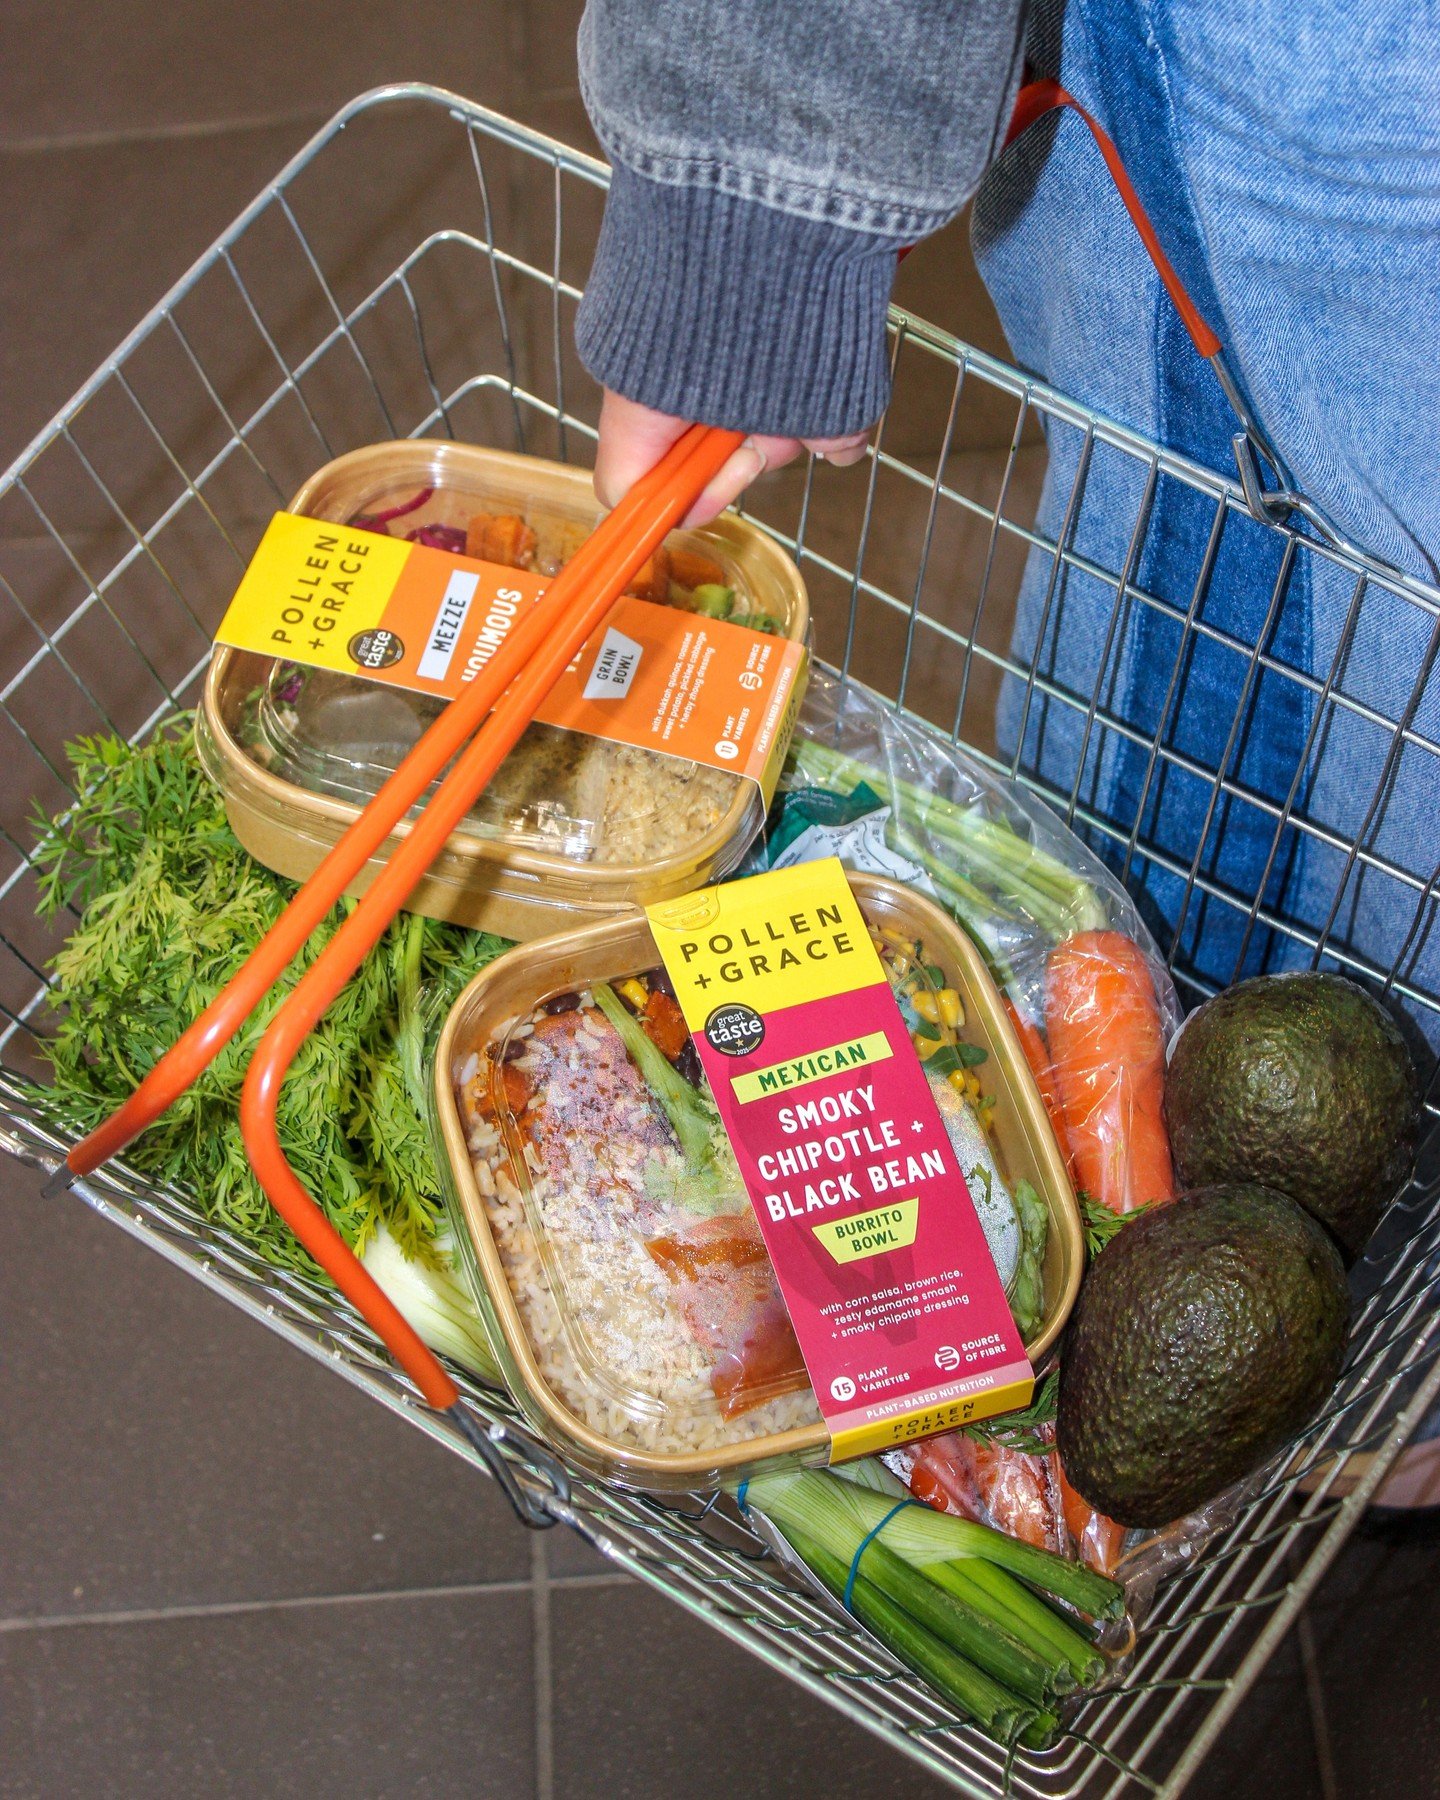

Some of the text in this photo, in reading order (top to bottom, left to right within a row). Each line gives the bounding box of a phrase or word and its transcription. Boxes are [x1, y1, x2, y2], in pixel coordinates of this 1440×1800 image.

[271, 535, 339, 643] POLLEN
[432, 597, 466, 652] MEZZE
[357, 636, 372, 656] great
[364, 631, 392, 667] taste
[745, 643, 761, 670] SOURCE
[597, 647, 618, 680] GRAIN
[612, 654, 634, 684] BOWL
[757, 662, 767, 673] OF
[651, 716, 662, 732] with
[657, 688, 672, 716] dukkah
[678, 632, 693, 660] roasted
[662, 717, 675, 739] sweet
[680, 662, 694, 690] pickled
[690, 631, 707, 664] cabbage
[680, 701, 696, 723] herby
[689, 678, 704, 700] zhoug
[697, 646, 716, 678] dressing
[721, 715, 735, 738] PLANT
[733, 706, 751, 741] VARIETIES
[757, 703, 779, 753] PLANT-BASED
[774, 667, 792, 705] NUTRITION
[721, 745, 733, 754] 11
[680, 904, 842, 963] POLLEN
[708, 1018, 763, 1044] taste
[717, 1011, 746, 1028] great
[758, 1043, 867, 1092] MEXICAN
[778, 1084, 876, 1134] SMOKY
[757, 1119, 924, 1181] CHIPOTLE +
[764, 1148, 946, 1222] BLACK BEAN
[834, 1209, 903, 1239] BURRITO
[851, 1229, 899, 1253] BOWL
[819, 1269, 964, 1316] with corn salsa, brown rice,
[834, 1283, 957, 1325] zesty edamame smash
[841, 1321, 876, 1338] smoky
[878, 1307, 921, 1327] chipotle
[923, 1294, 970, 1314] dressing
[961, 1333, 1000, 1352] SOURCE
[965, 1344, 1007, 1362] OF FIBRE
[834, 1382, 852, 1397] 15
[857, 1366, 889, 1382] PLANT
[861, 1372, 910, 1393] VARIETIES
[866, 1375, 995, 1419] PLANT-BASED NUTRITION
[893, 1402, 975, 1432] POLLEN
